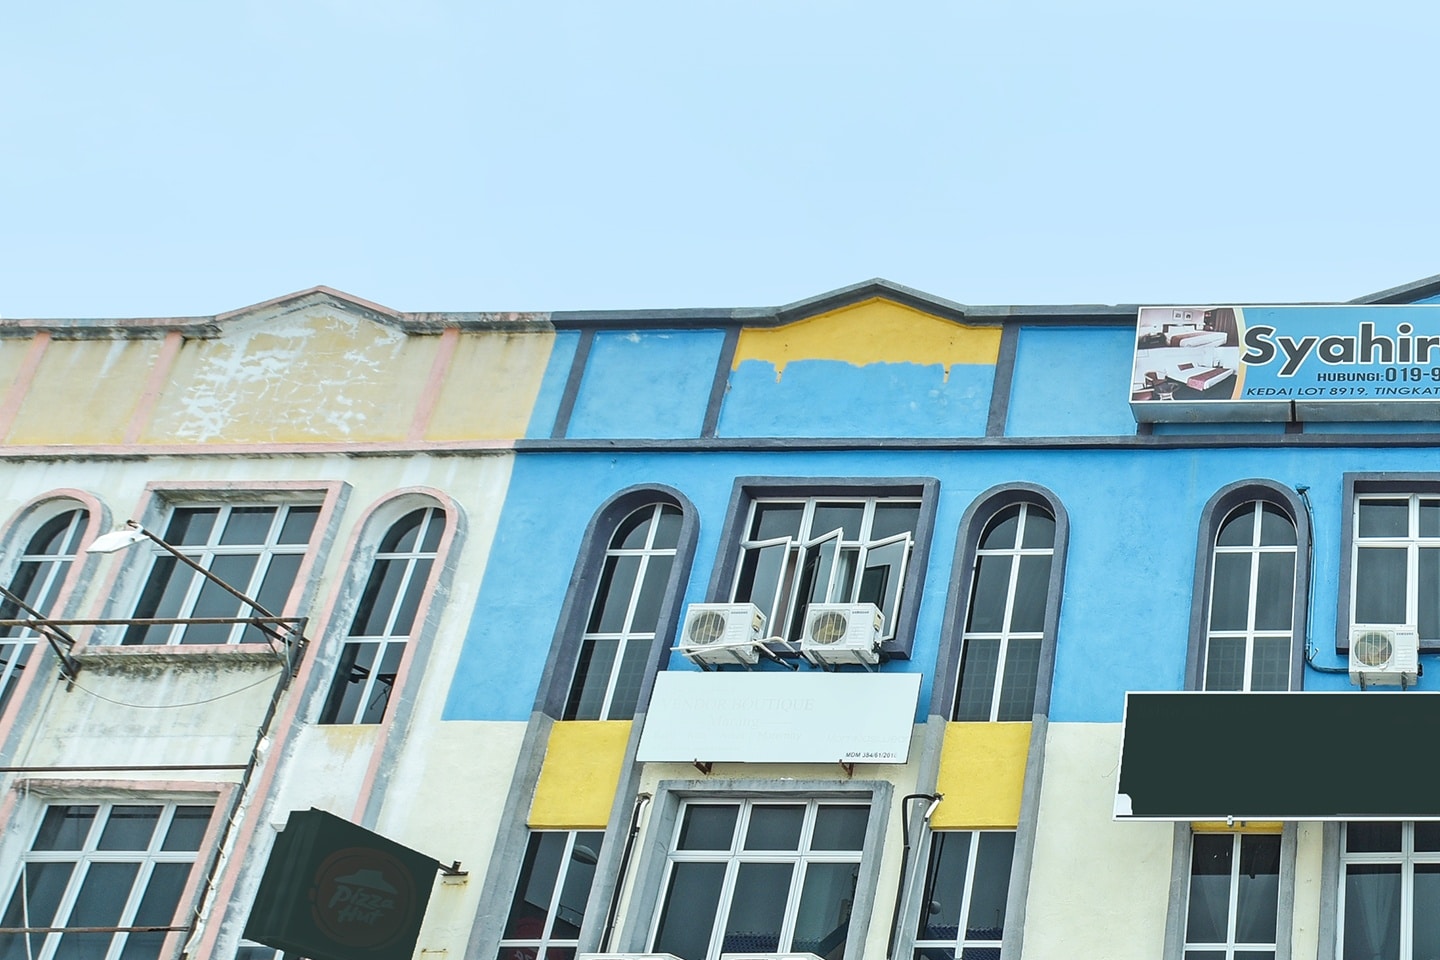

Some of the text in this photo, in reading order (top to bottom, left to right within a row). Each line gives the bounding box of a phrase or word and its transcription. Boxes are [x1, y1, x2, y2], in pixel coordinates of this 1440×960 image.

[1247, 388, 1293, 396] KEDAI
[1329, 387, 1369, 396] 8919,
[1374, 387, 1440, 395] TINGKAT
